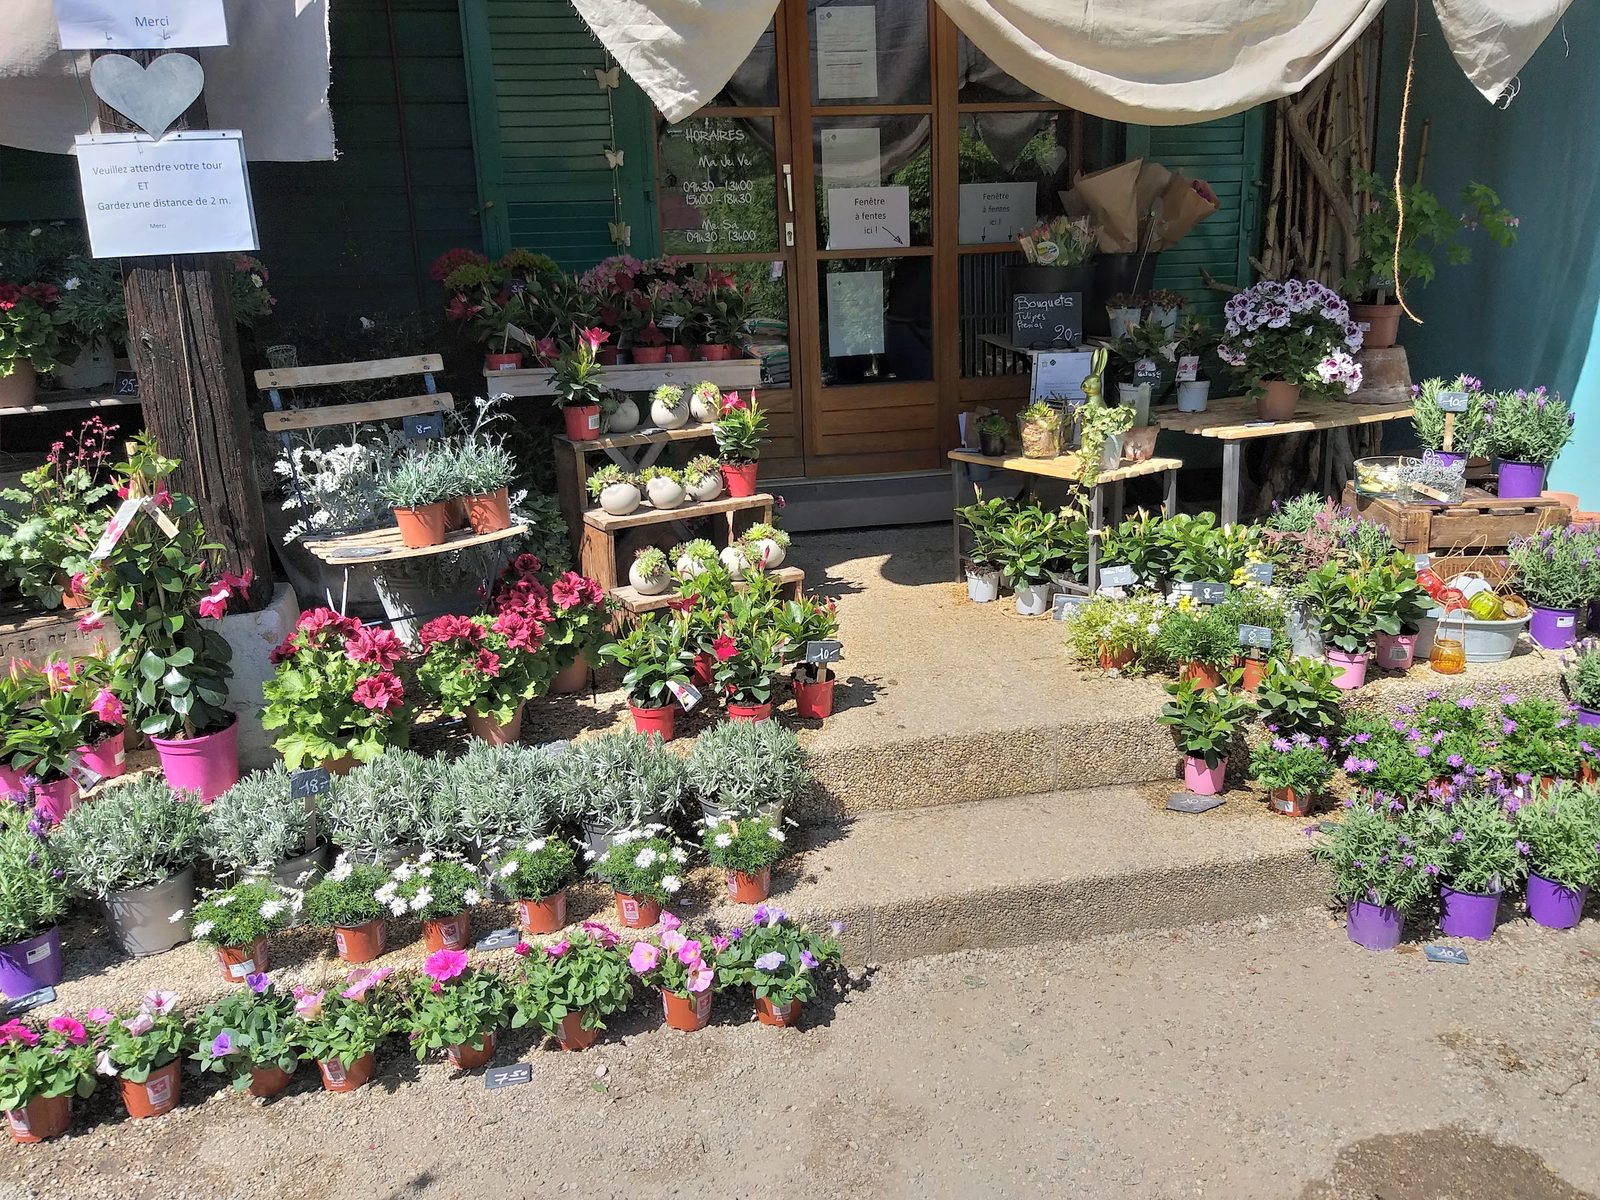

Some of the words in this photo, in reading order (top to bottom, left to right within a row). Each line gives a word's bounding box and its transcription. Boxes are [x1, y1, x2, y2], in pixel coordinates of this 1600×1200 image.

[135, 16, 169, 27] Merci
[685, 128, 745, 142] HORAIRES
[92, 166, 128, 176] Veuillez
[130, 163, 171, 174] attendre
[173, 162, 200, 172] votre
[202, 161, 223, 171] tour
[137, 182, 149, 191] ET
[683, 180, 715, 193] 09h30
[725, 180, 753, 192] 13h00
[686, 194, 714, 206] 15h00
[724, 192, 752, 204] 18h30
[982, 191, 1009, 201] Fenêtre
[97, 201, 131, 212] Gardez
[132, 200, 151, 209] une
[153, 197, 194, 209] distance
[195, 196, 208, 206] de
[210, 196, 216, 205] 2
[219, 198, 232, 206] m.
[854, 197, 885, 207] Fenêtre
[982, 205, 987, 213] à
[988, 204, 1010, 213] fentes
[855, 212, 860, 220] à
[861, 211, 887, 220] fentes
[149, 222, 167, 230] Merci
[990, 218, 998, 226] ici
[864, 226, 873, 235] ici
[686, 231, 718, 243] 09h30
[728, 230, 756, 242] 13h00
[1015, 294, 1074, 311] Bouquets
[1015, 312, 1046, 323] Tulipes
